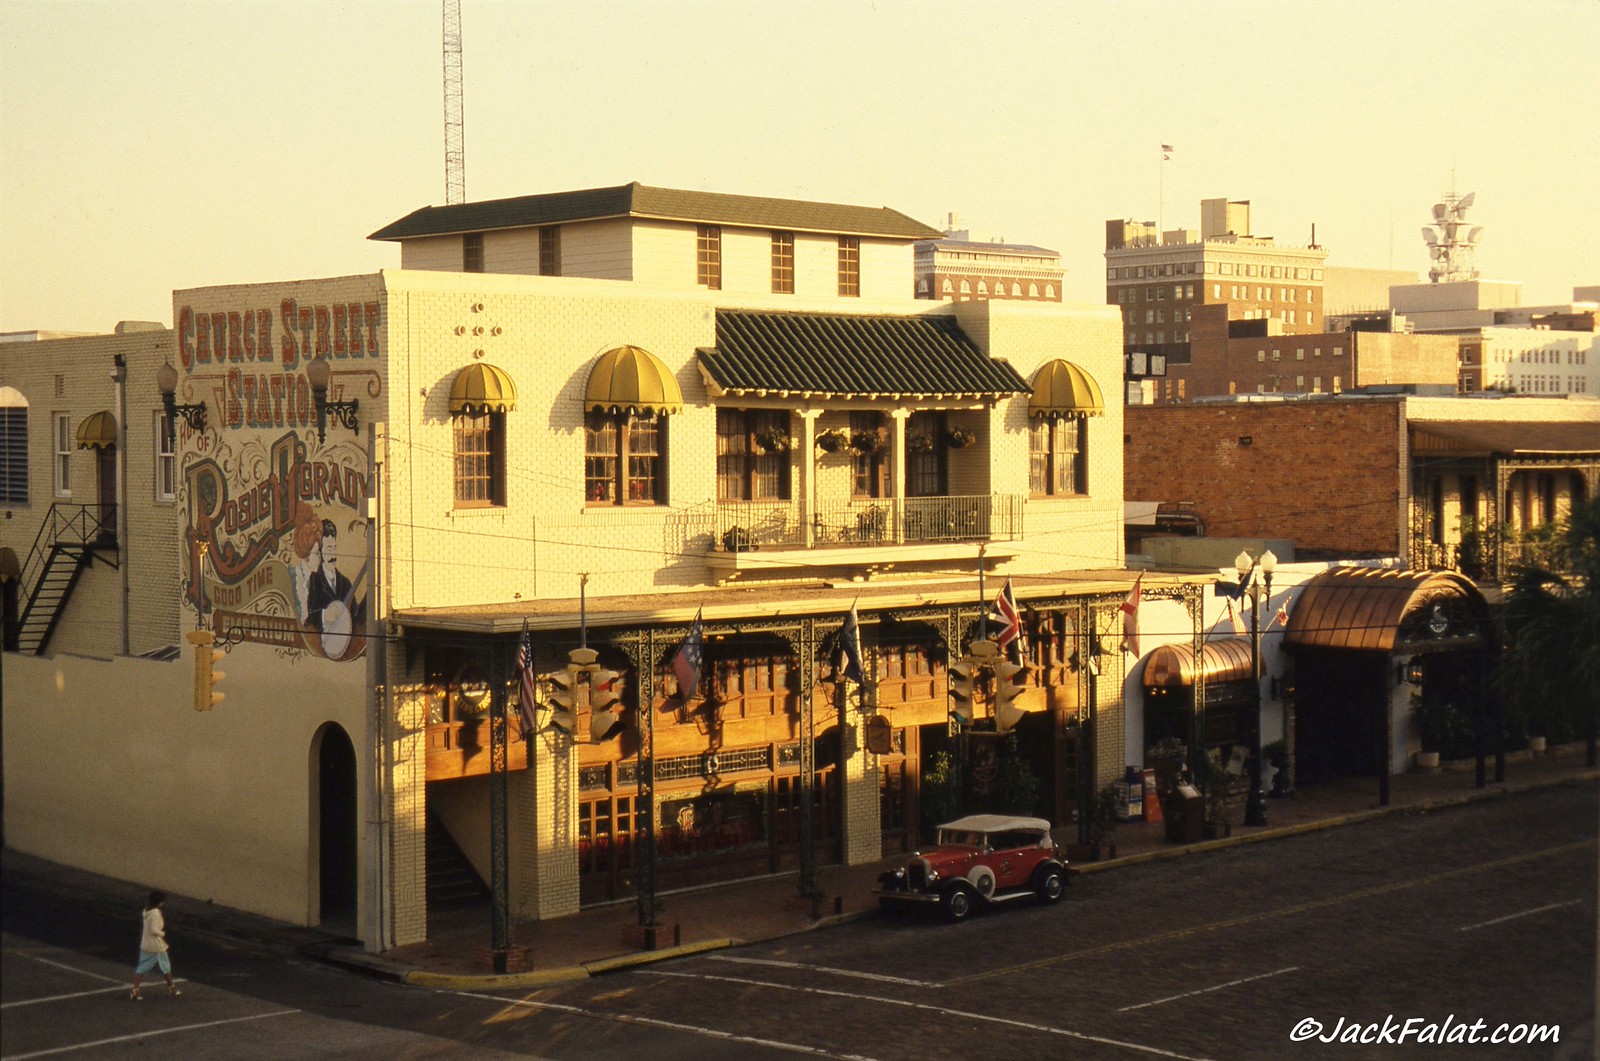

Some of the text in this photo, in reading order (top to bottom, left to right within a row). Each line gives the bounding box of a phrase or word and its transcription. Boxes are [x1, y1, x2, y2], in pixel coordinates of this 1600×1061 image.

[179, 298, 381, 373] CHURCH STREET
[197, 435, 210, 452] OF
[184, 457, 279, 614] ROSIE
[213, 566, 273, 607] GOOD TIME
[222, 615, 295, 642] EMPORIUM
